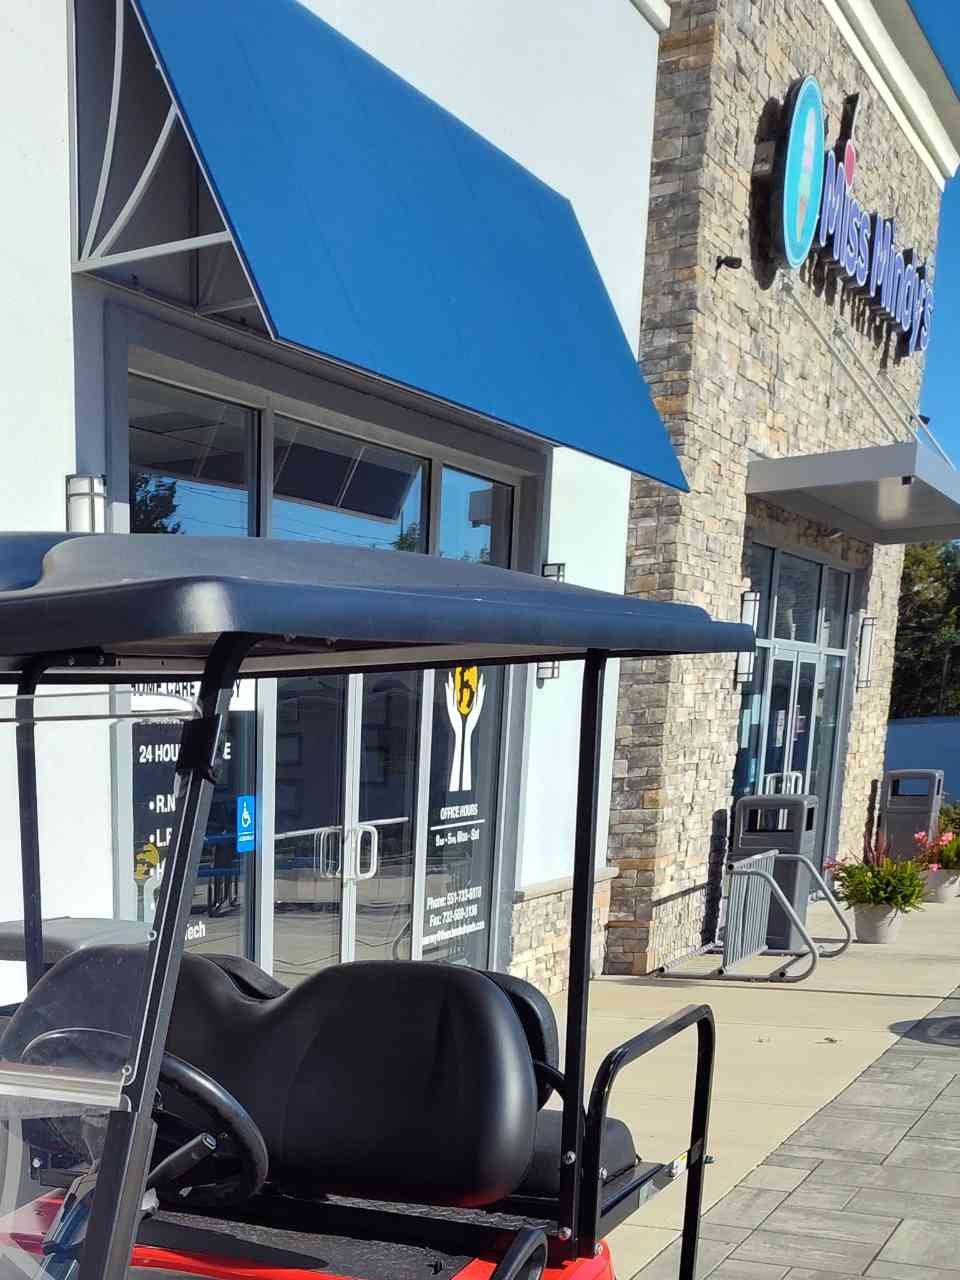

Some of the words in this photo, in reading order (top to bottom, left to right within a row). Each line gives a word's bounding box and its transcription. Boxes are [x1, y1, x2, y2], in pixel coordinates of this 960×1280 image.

[819, 148, 871, 286] Miss
[869, 210, 934, 354] Mindy's
[139, 744, 153, 763] 24
